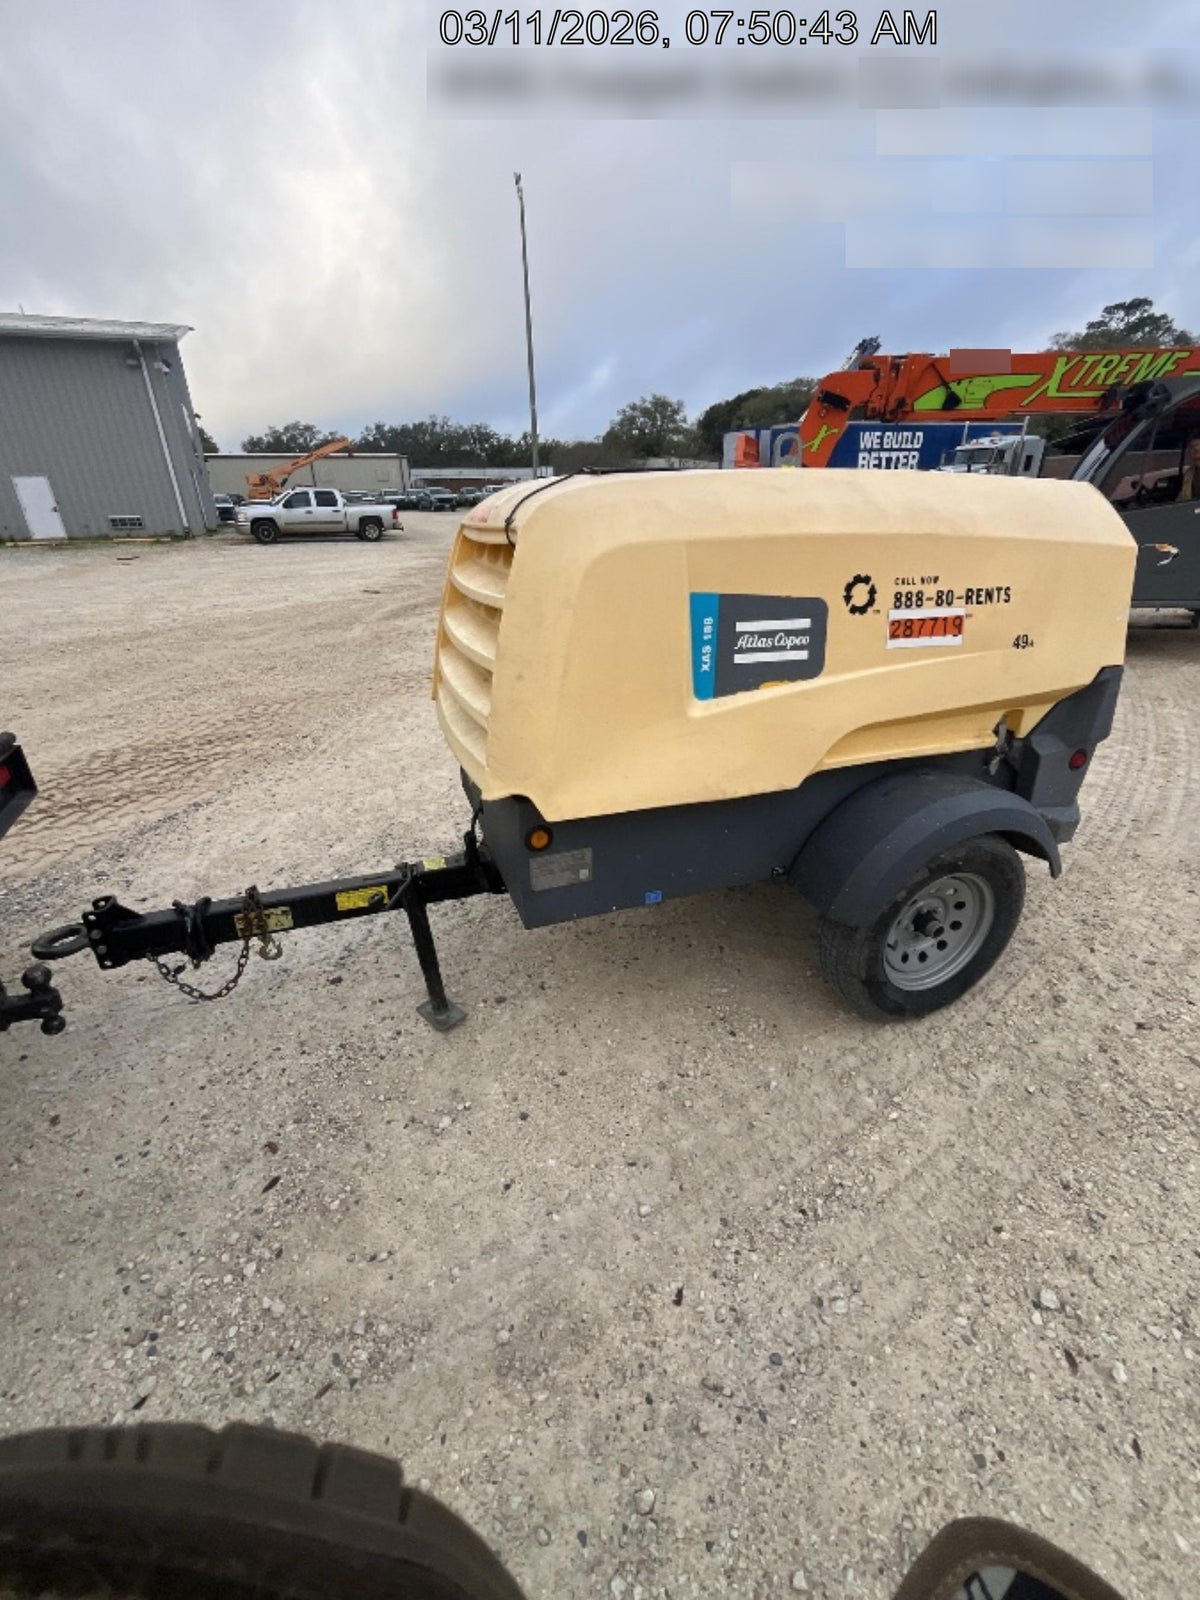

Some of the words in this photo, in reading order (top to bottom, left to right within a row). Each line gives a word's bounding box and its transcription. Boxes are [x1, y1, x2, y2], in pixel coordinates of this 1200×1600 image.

[1020, 351, 1191, 406] XTREME
[859, 431, 878, 449] WE
[882, 431, 924, 449] BUILD
[858, 451, 919, 470] BETTER
[894, 577, 917, 586] CALL
[920, 575, 940, 585] NOW
[893, 586, 1011, 609] 888-80-RENTS
[890, 615, 964, 638] 287719
[733, 634, 774, 649] Atlas
[774, 632, 810, 650] Copco
[701, 645, 712, 672] XAS
